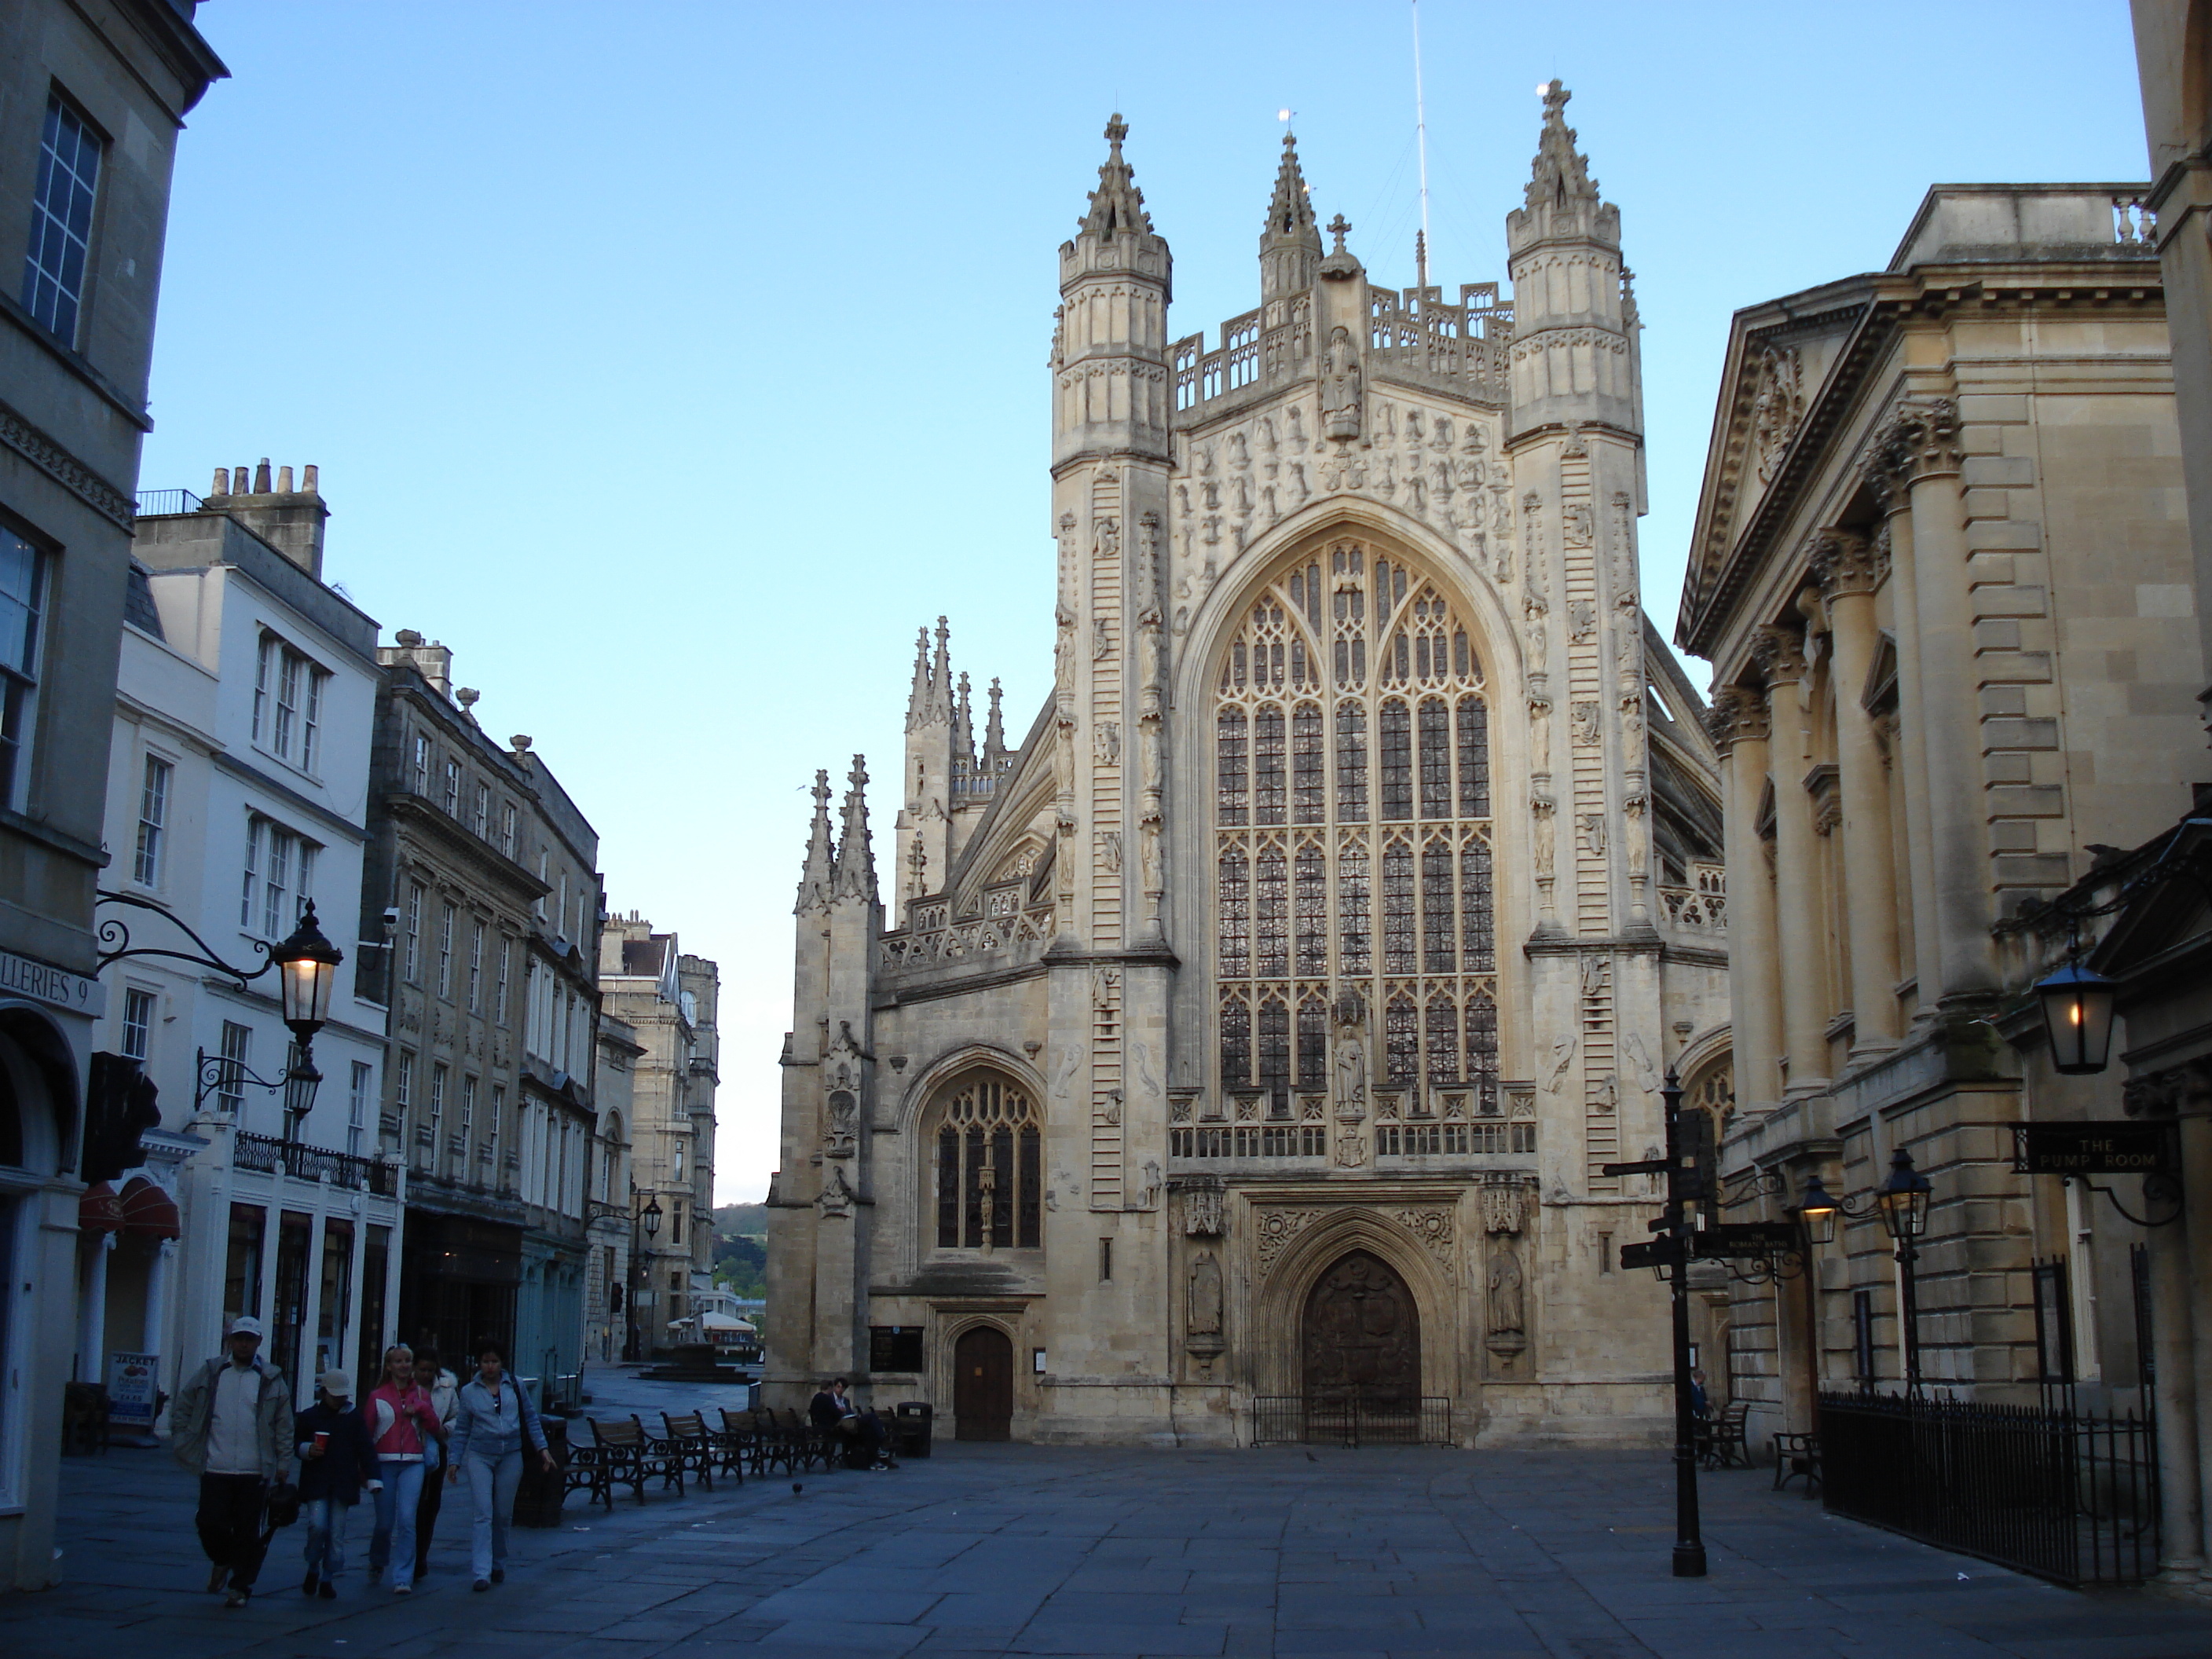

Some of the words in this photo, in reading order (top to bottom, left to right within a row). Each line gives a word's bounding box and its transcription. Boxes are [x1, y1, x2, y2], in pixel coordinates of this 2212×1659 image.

[79, 980, 87, 1006] 9
[2078, 1139, 2115, 1152] THE
[2039, 1155, 2090, 1167] PUMP
[2104, 1154, 2156, 1167] ROOM
[115, 1356, 155, 1366] JACKET
